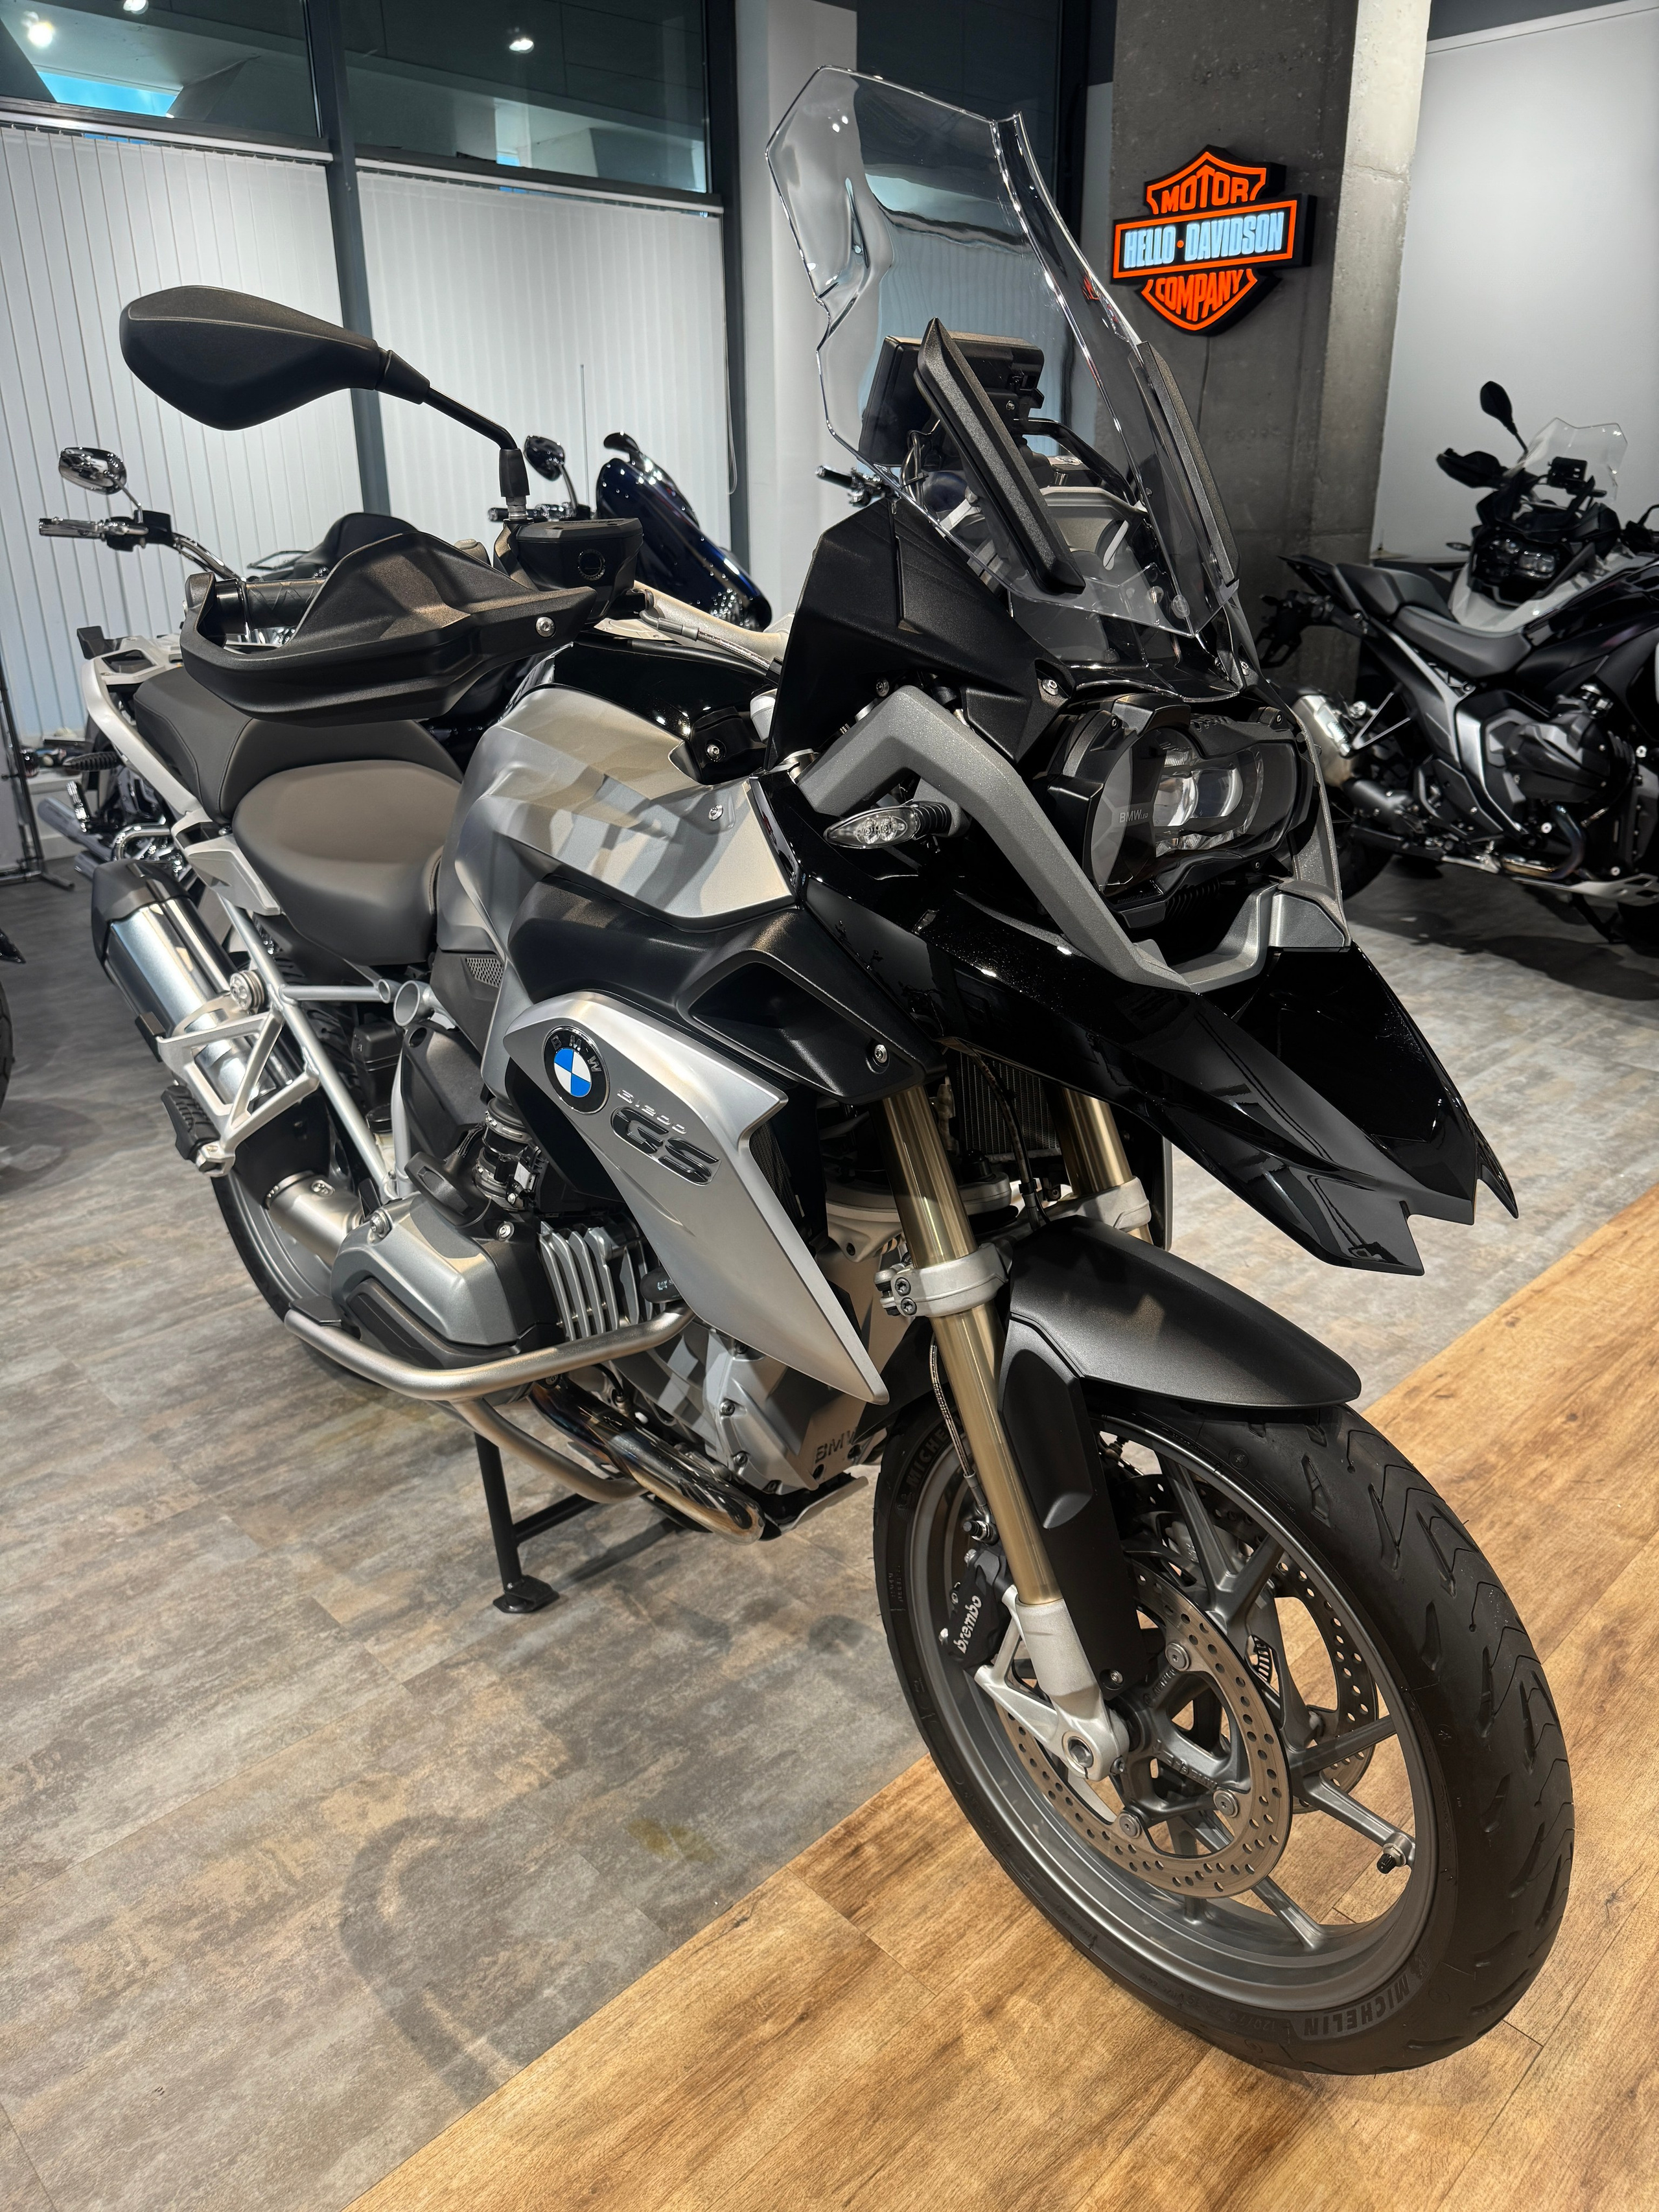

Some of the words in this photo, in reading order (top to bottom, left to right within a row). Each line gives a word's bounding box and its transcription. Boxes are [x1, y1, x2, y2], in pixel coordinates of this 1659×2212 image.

[1161, 165, 1249, 214] MOTOR
[1184, 211, 1284, 262] DAVIDSON
[1155, 269, 1244, 322] COMPANY
[1119, 809, 1141, 823] BMW
[551, 1034, 601, 1073] BMW
[611, 1106, 722, 1185] GS
[953, 1595, 982, 1654] brembo
[1303, 1973, 1411, 2036] MICHELIN
